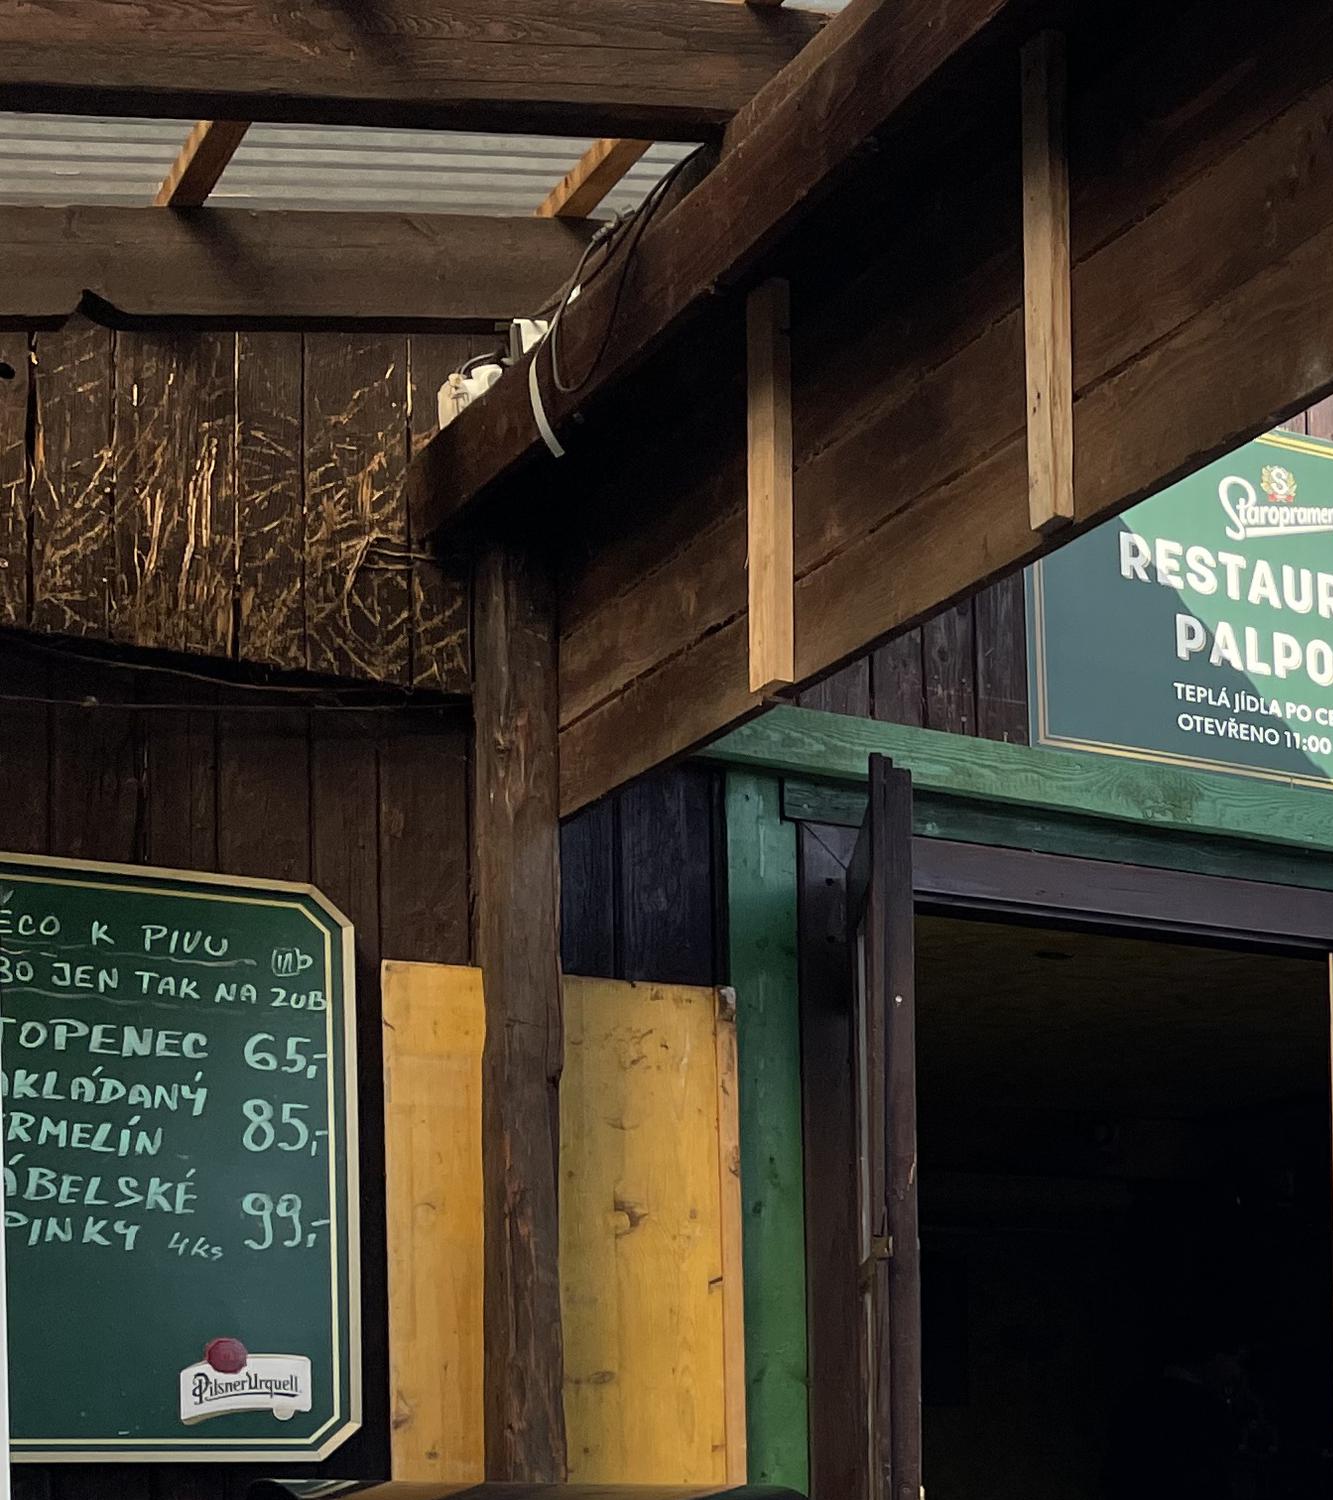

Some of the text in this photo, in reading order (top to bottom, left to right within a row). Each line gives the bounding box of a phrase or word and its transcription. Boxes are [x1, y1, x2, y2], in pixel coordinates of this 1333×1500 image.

[1173, 682, 1231, 709] TEPLÁ
[1233, 690, 1283, 718] JÍDLA
[1285, 701, 1312, 722] PO
[1177, 713, 1280, 746] OTEVŘENO
[1284, 730, 1332, 755] 11:00
[91, 920, 115, 945] K
[141, 924, 229, 957] PIVU
[51, 962, 119, 993] JEN
[134, 971, 200, 1000] TAK
[214, 983, 257, 1005] NA
[243, 1032, 327, 1079] 65,-
[4, 1111, 163, 1157] RMELÍN
[242, 1098, 329, 1157] 85,-
[242, 1192, 330, 1250] 99,-
[168, 1231, 223, 1261] 4ks
